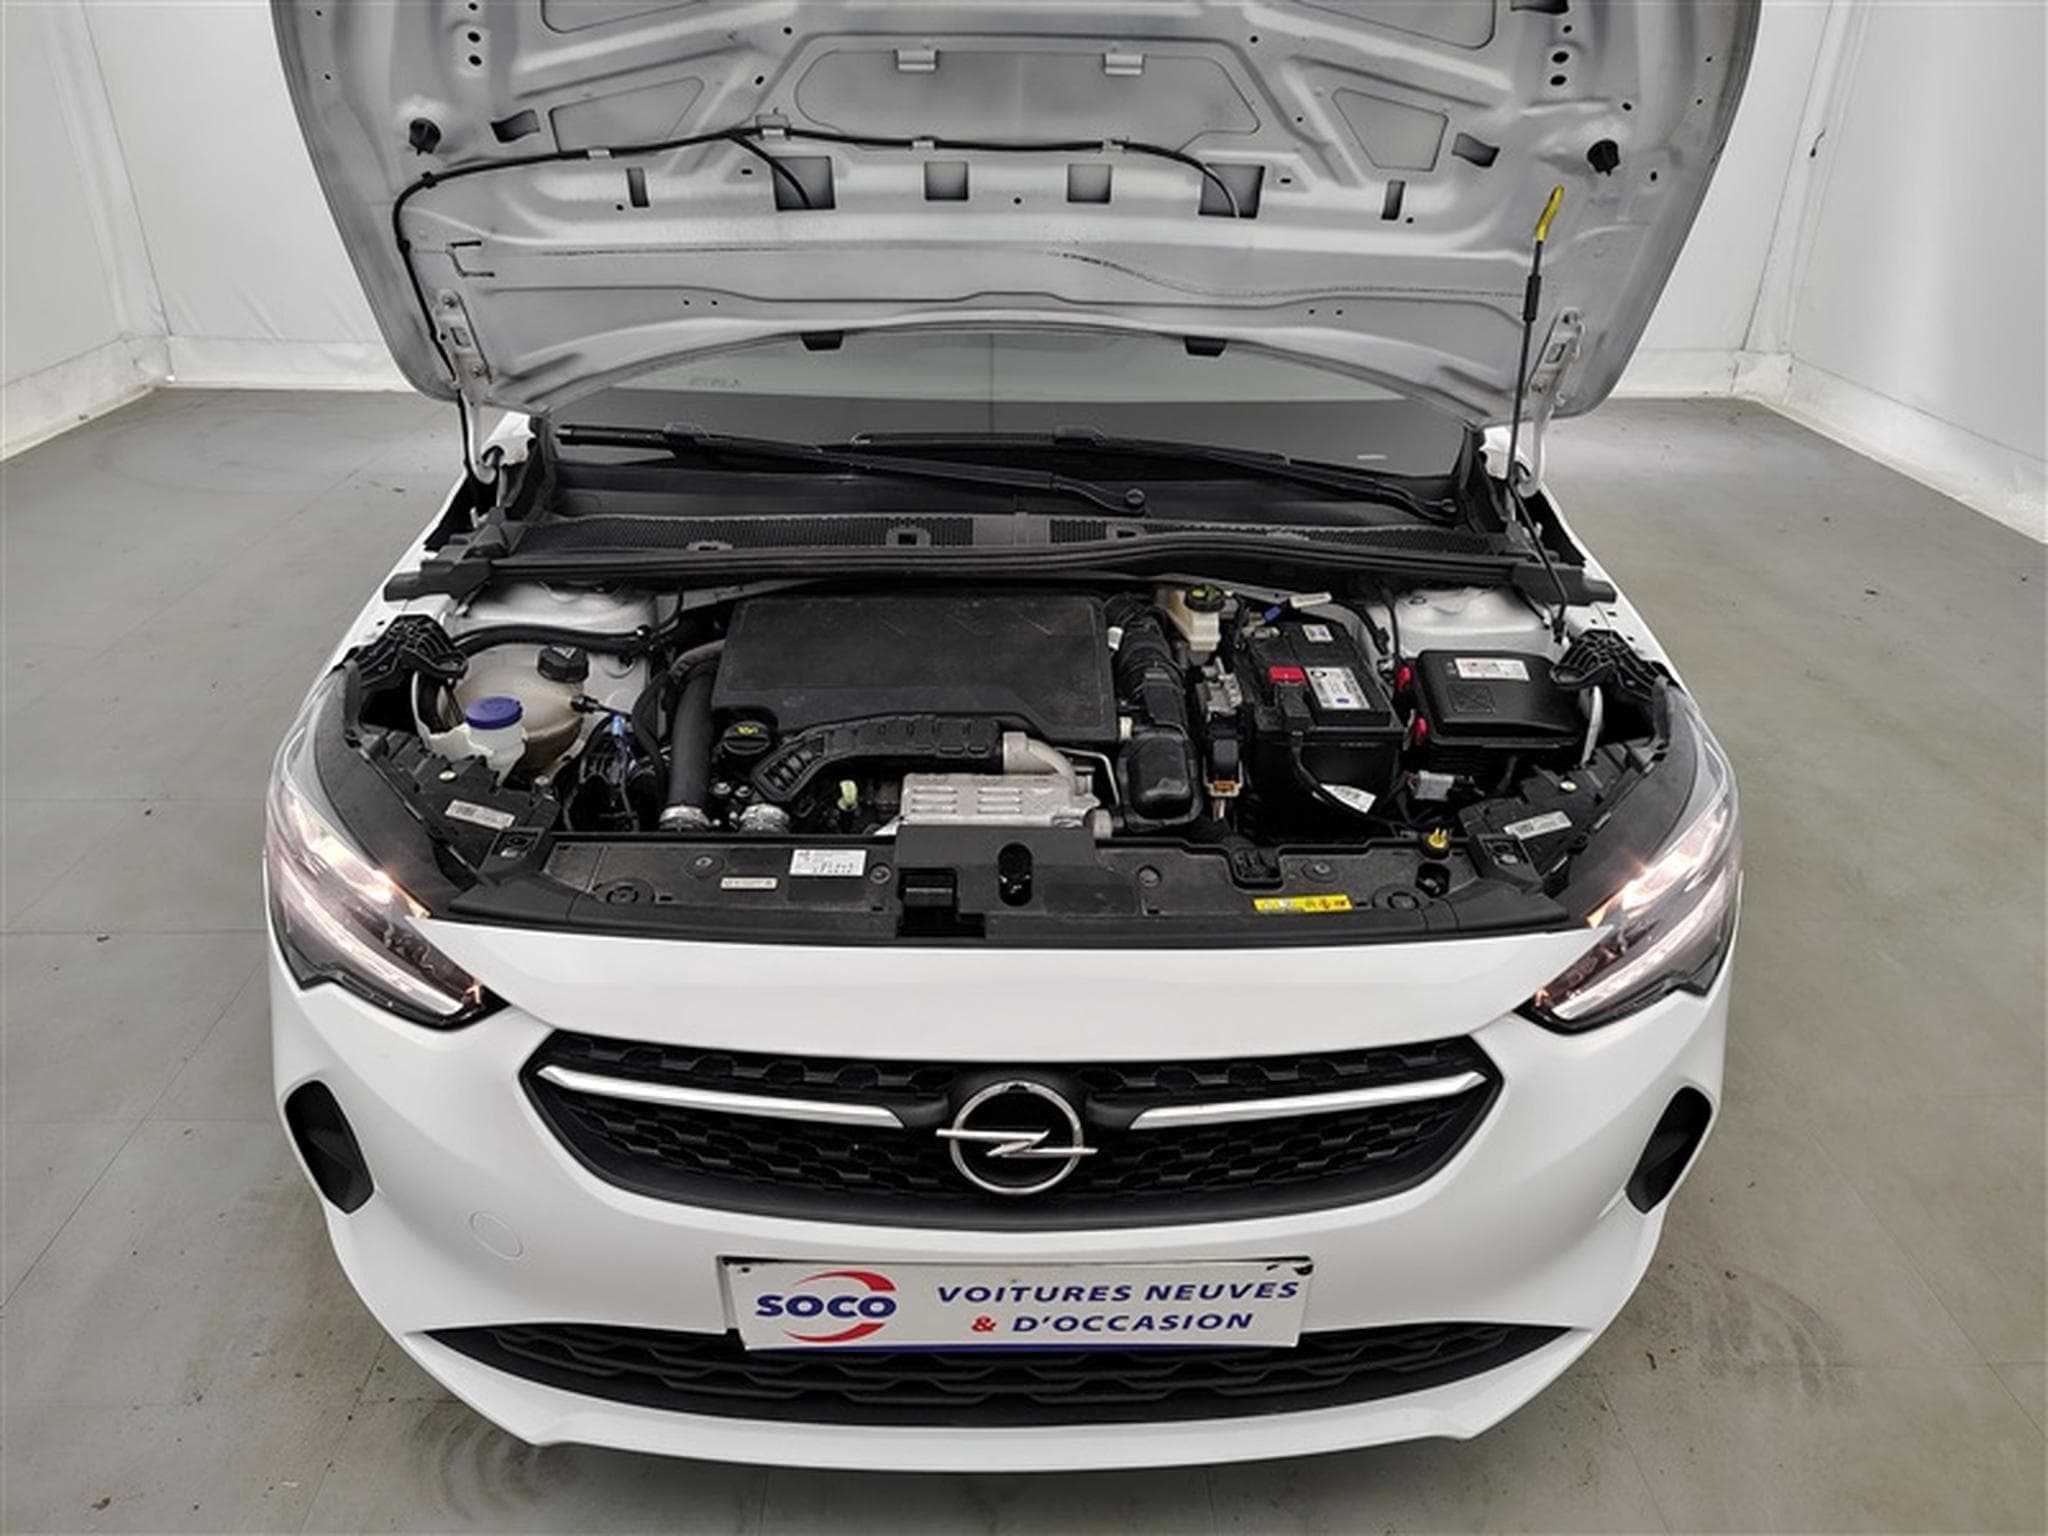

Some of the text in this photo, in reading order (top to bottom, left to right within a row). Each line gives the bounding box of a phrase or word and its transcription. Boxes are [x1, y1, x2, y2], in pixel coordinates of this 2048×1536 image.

[937, 1281, 1300, 1302] VOITURES NEUVES
[755, 1294, 897, 1319] SOCO
[971, 1312, 1253, 1333] & D'OCCASION
